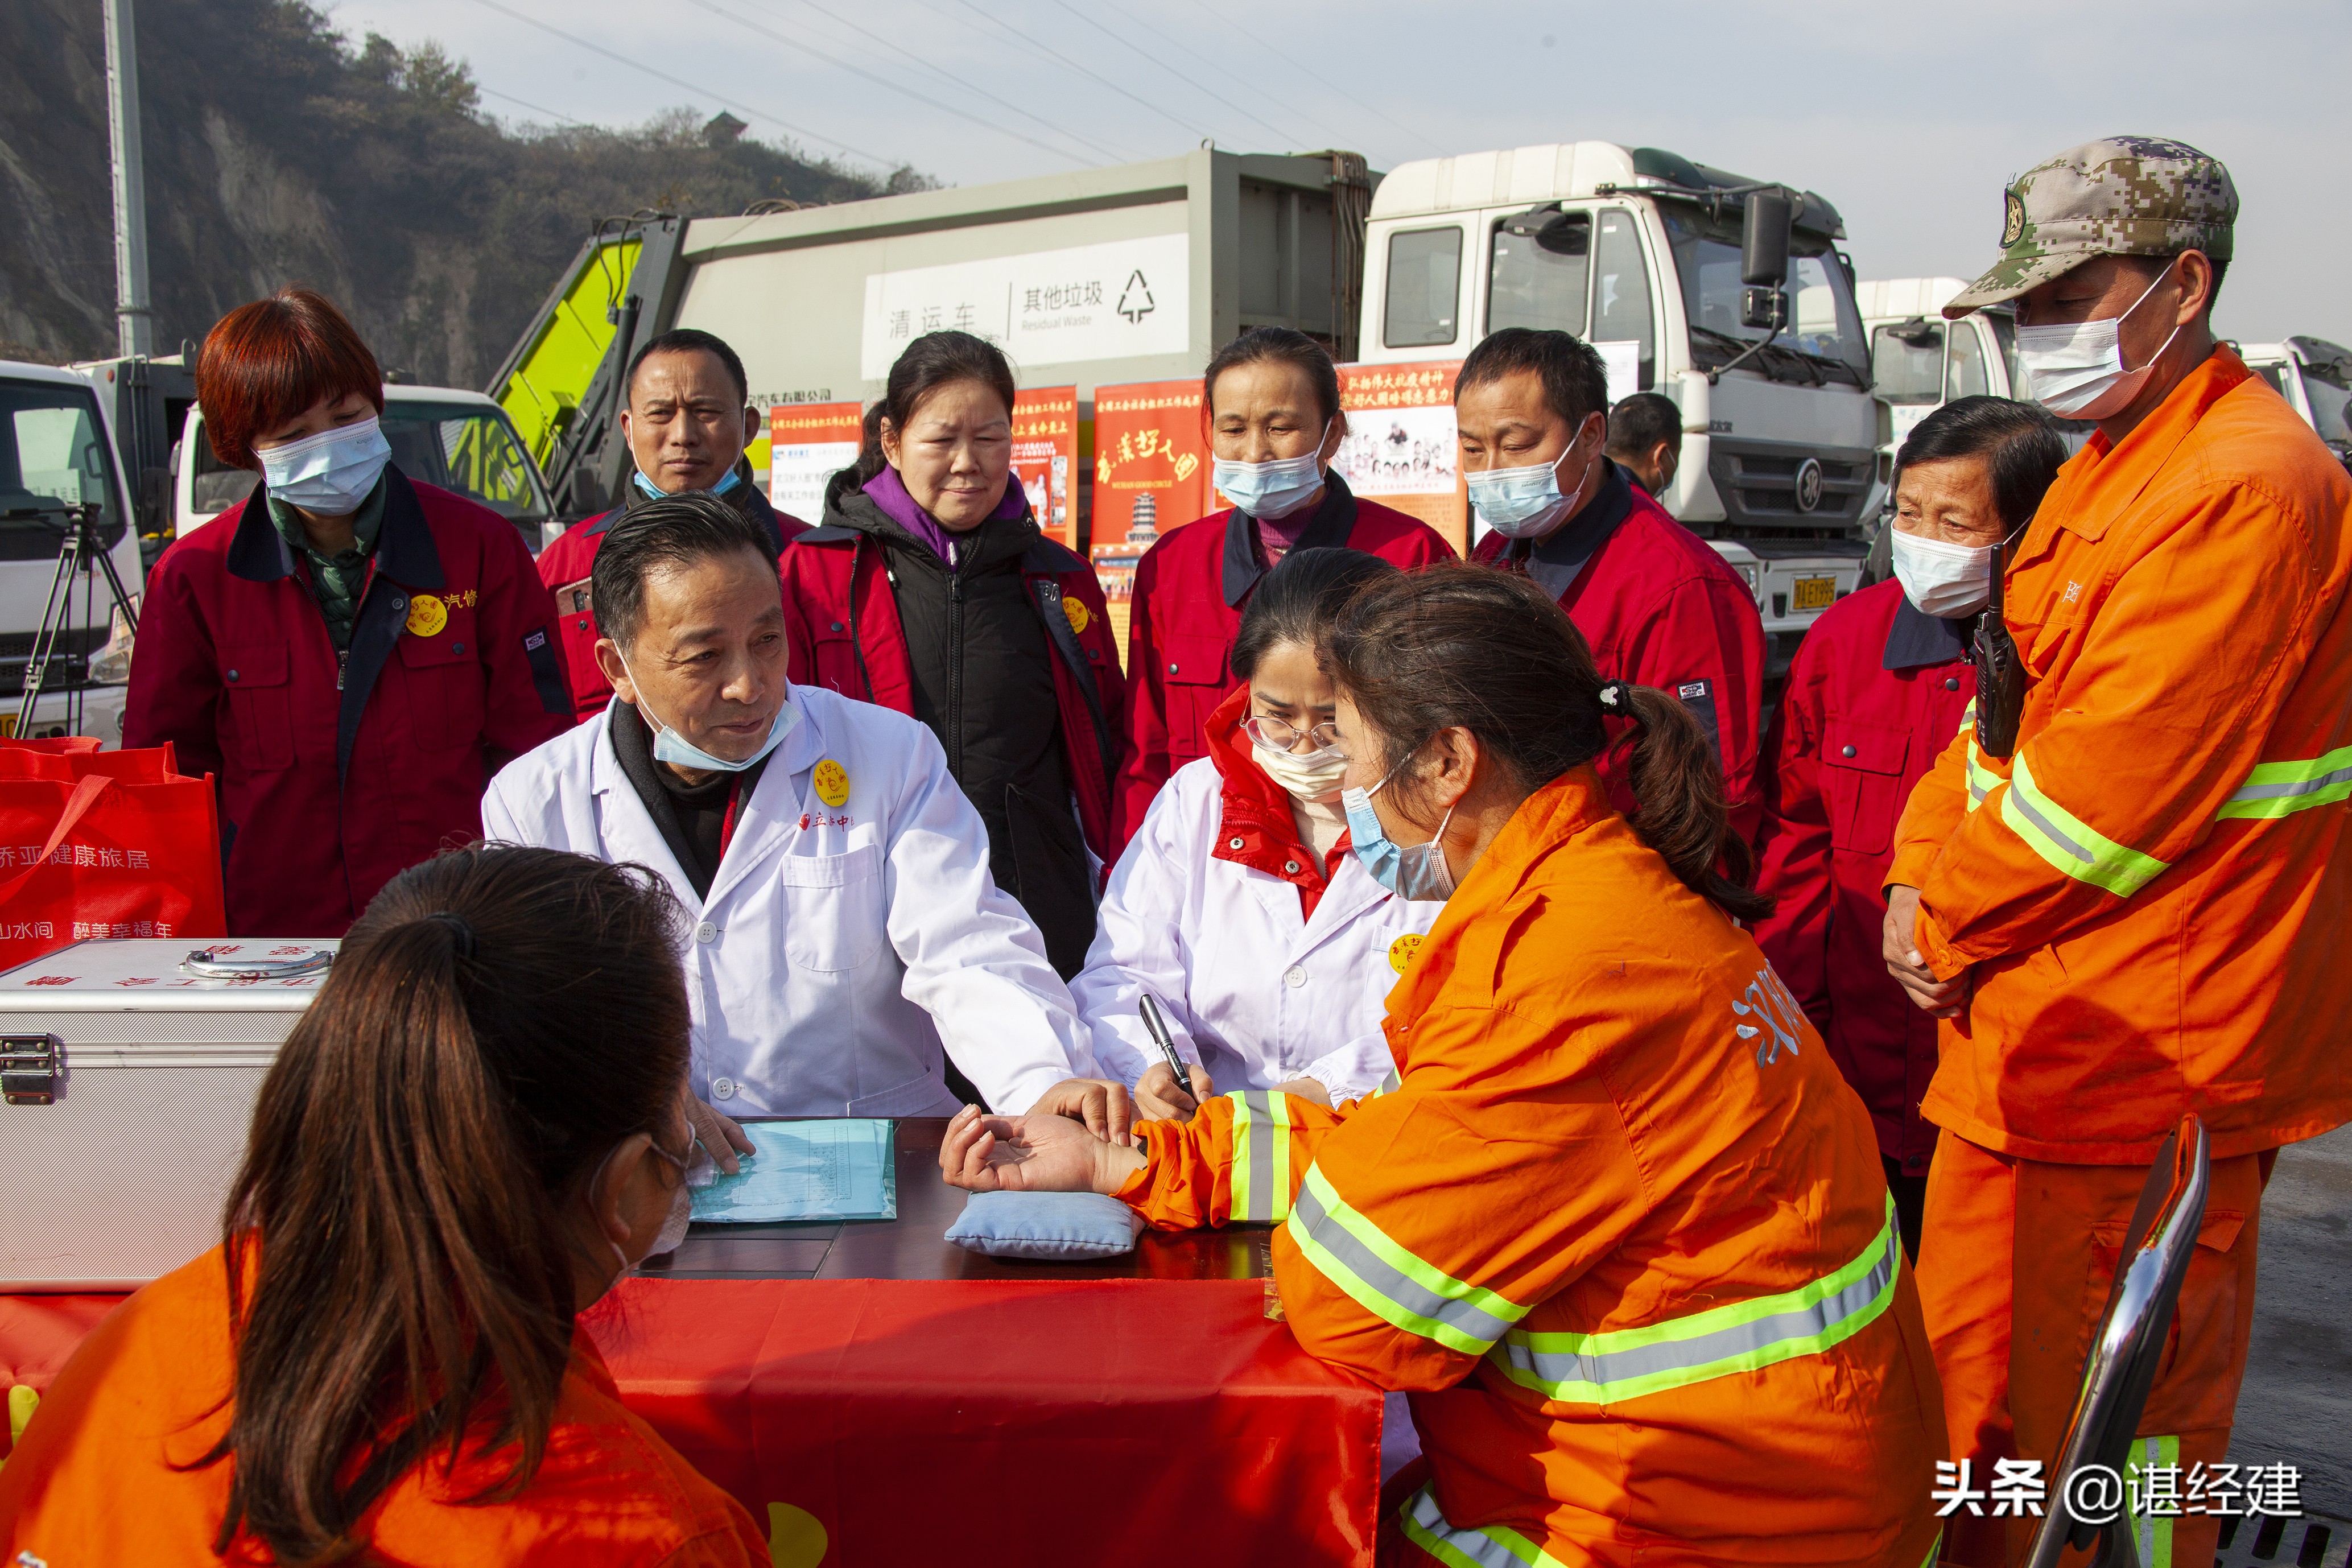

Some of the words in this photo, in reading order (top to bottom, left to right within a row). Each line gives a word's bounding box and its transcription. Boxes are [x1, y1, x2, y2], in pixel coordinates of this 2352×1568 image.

[1024, 281, 1103, 313] 其他垃圾
[890, 302, 976, 340] 清运车
[1022, 317, 1061, 331] Residual
[1063, 315, 1092, 327] Waste
[1347, 369, 1445, 391] 弘扬伟大抗疫精神
[1028, 420, 1068, 436] 生命至上
[1153, 480, 1173, 488] CIRCLE
[73, 921, 172, 939] 醉美幸福年
